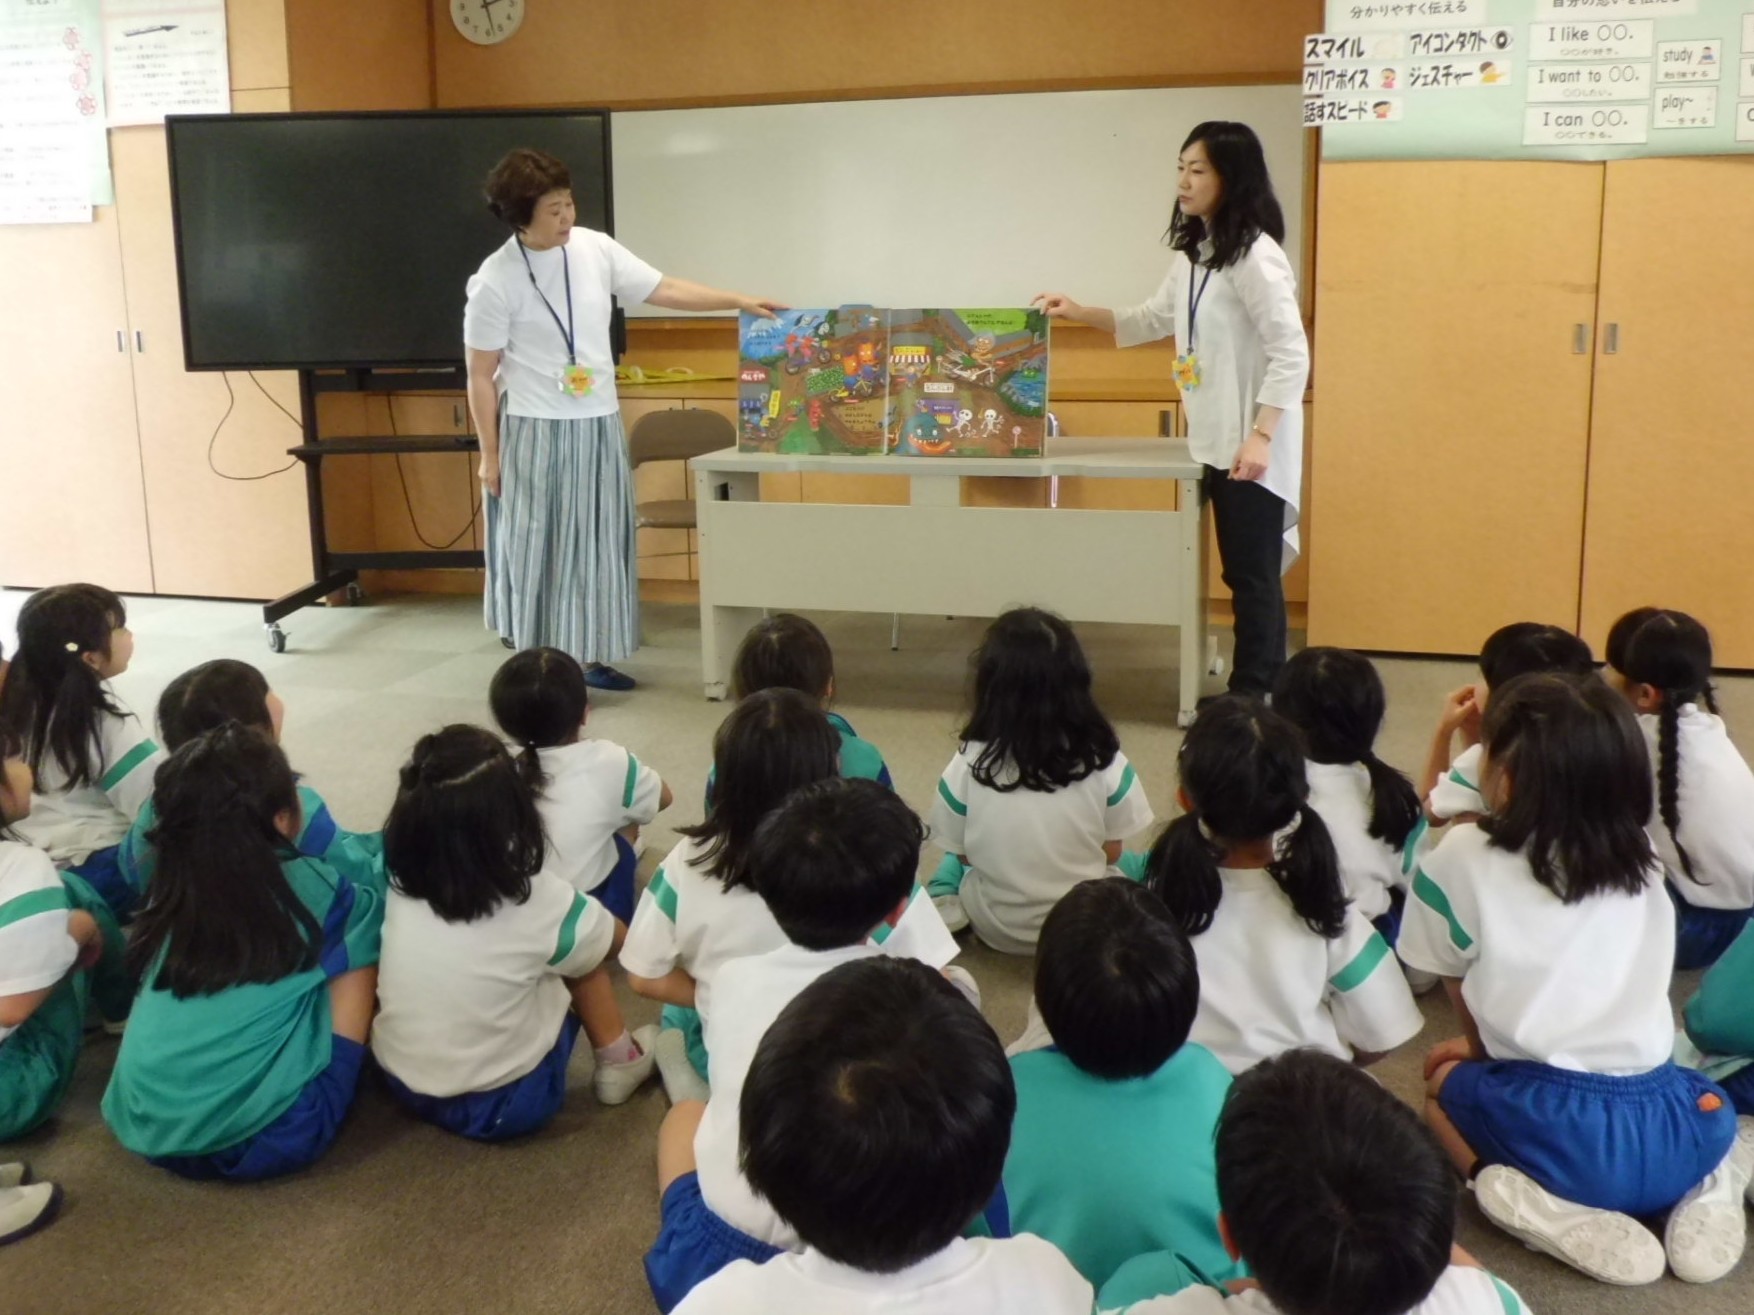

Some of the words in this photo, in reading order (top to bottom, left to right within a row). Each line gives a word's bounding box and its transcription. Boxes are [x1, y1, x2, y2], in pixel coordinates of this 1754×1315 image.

[1350, 0, 1467, 19] 分かりやすく伝える
[1410, 30, 1487, 54] アイコンタクト
[1549, 27, 1555, 42] I
[1561, 26, 1589, 41] like
[1306, 36, 1365, 58] スマイル
[1663, 47, 1693, 64] study
[1305, 68, 1369, 90] クリアボイス
[1409, 64, 1473, 86] ジェスチャー
[1538, 69, 1544, 83] I
[1549, 70, 1580, 83] want
[1588, 70, 1601, 83] to
[1304, 101, 1367, 122] 話すスピード
[1544, 112, 1550, 126] I
[1555, 115, 1583, 126] can
